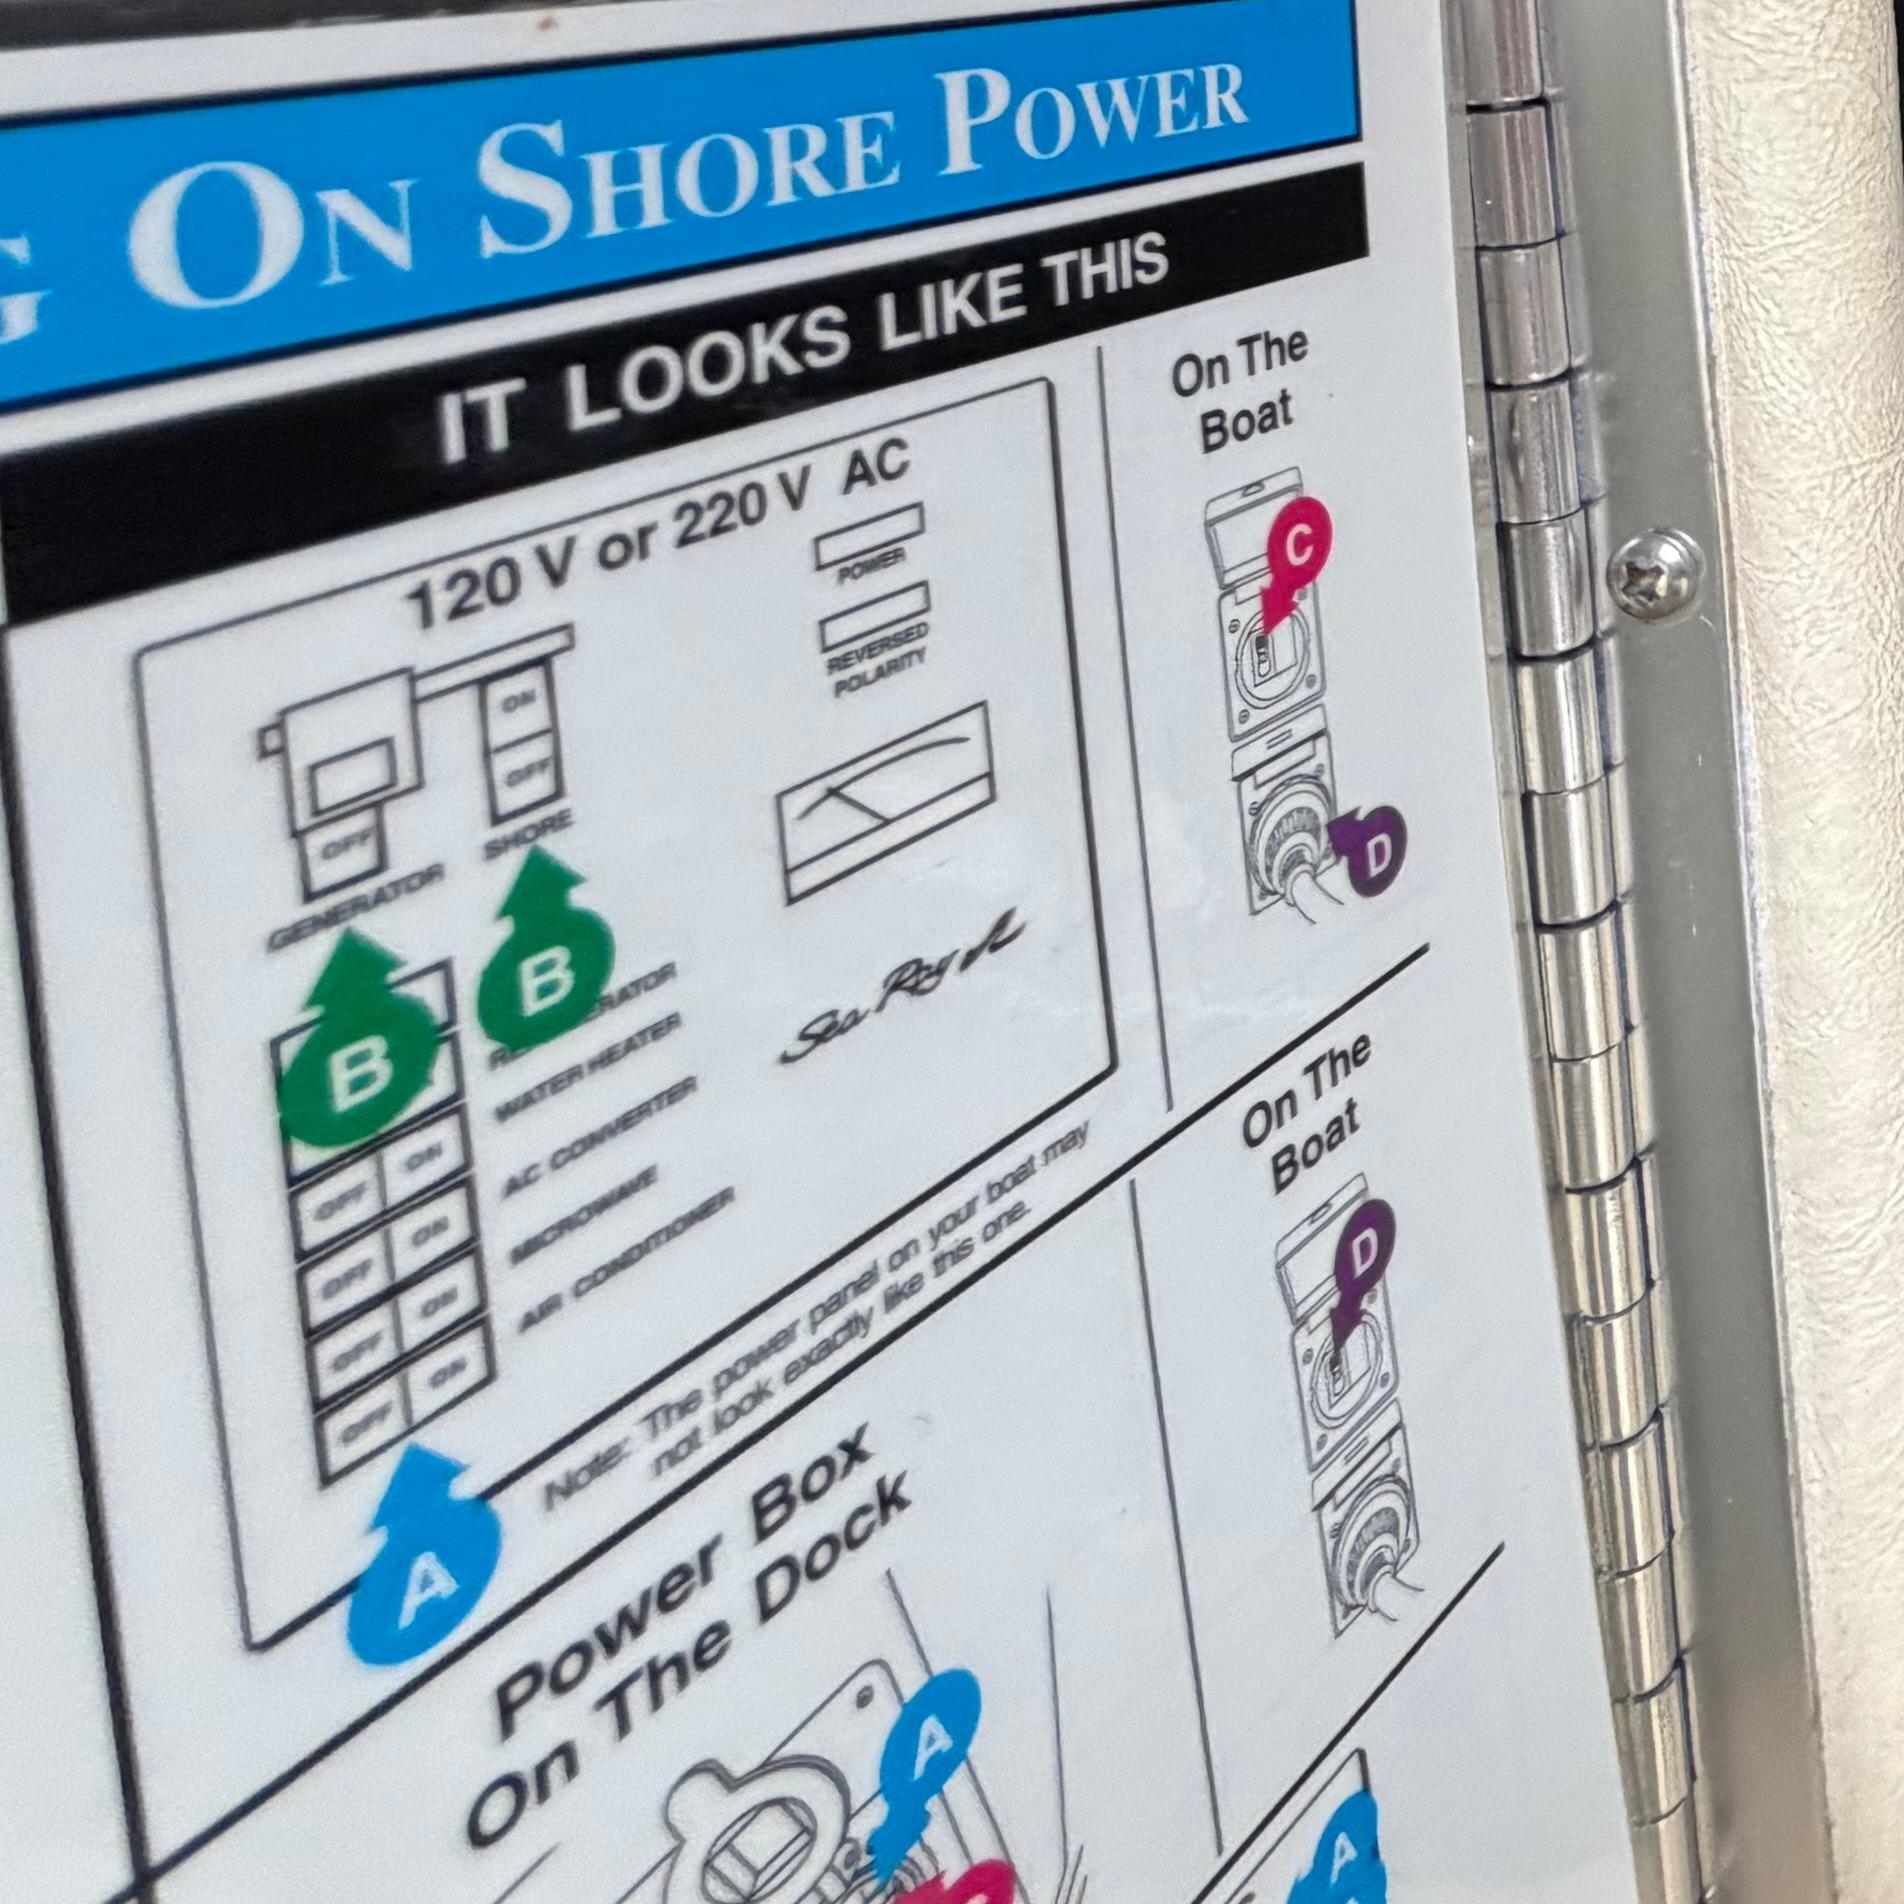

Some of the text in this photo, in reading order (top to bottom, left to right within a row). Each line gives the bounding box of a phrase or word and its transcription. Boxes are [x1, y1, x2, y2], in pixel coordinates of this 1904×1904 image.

[437, 231, 1170, 465] IT LOOKS LIKE THIS
[1171, 325, 1309, 398] On The
[1200, 388, 1294, 455] Boat
[405, 438, 912, 629] 120 V or 220 V AC
[1285, 523, 1313, 566] C
[836, 546, 907, 584] POWER
[826, 620, 930, 676] REVERSED
[833, 645, 928, 698] POLARITY
[500, 688, 537, 714] ON
[505, 756, 555, 789] OFF
[320, 829, 376, 861] OFF
[483, 806, 576, 861] SHORE
[1367, 832, 1392, 878] D
[266, 861, 447, 954] GENERATOR
[518, 945, 576, 1017] B
[329, 1035, 394, 1115] B
[1242, 1031, 1371, 1151] On The
[405, 1141, 443, 1173] ON
[1272, 1099, 1359, 1196] Boat
[505, 1163, 542, 1198] AC
[411, 1215, 450, 1248] ON
[1352, 1229, 1379, 1273] D
[541, 1119, 1091, 1514] Note: The power panel on your boat may
[650, 1198, 1033, 1479] not look exactly like this one.
[429, 1355, 468, 1391] ON
[400, 1552, 459, 1629] A
[493, 1421, 878, 1743] Power Box
[466, 1469, 913, 1850] On The Dock
[913, 1715, 953, 1781] A
[1330, 1832, 1357, 1886] A
